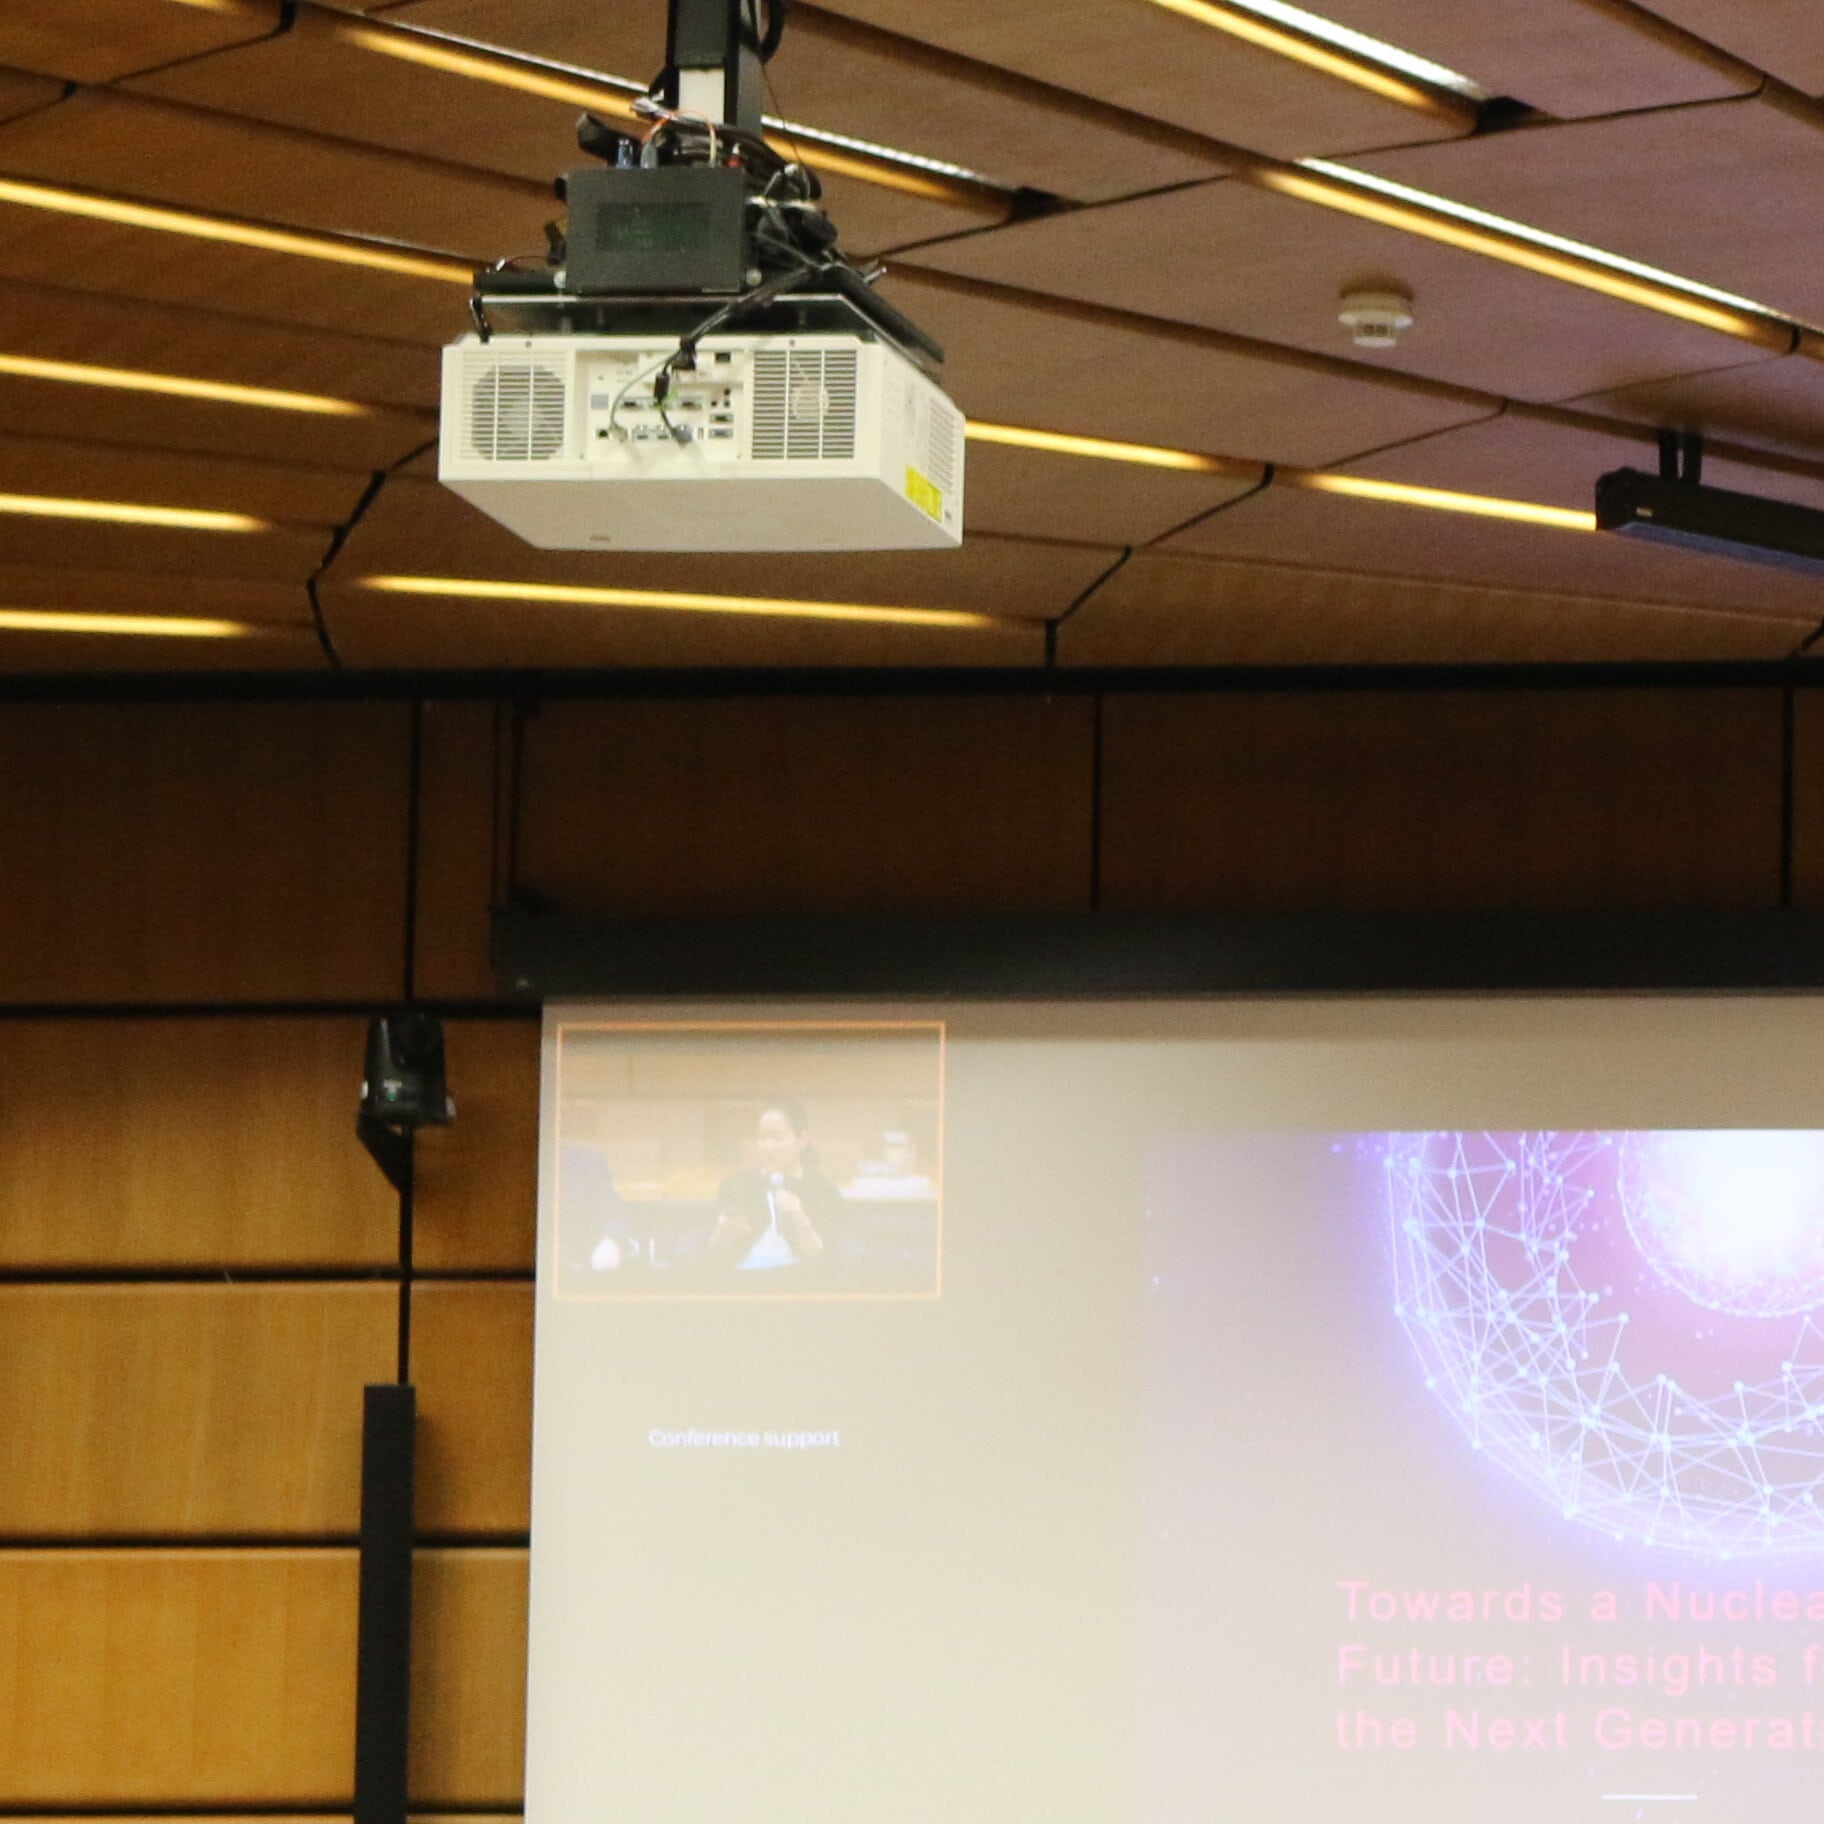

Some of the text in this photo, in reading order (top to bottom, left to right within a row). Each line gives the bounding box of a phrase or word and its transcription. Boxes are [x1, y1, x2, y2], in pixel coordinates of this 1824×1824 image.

[648, 1426, 840, 1450] Conference support
[1337, 1580, 1566, 1622] Towards
[1590, 1590, 1618, 1622] a
[1336, 1645, 1531, 1686] Future:
[1560, 1644, 1777, 1697] Insights
[1335, 1709, 1419, 1750] the
[1446, 1709, 1569, 1751] Next
